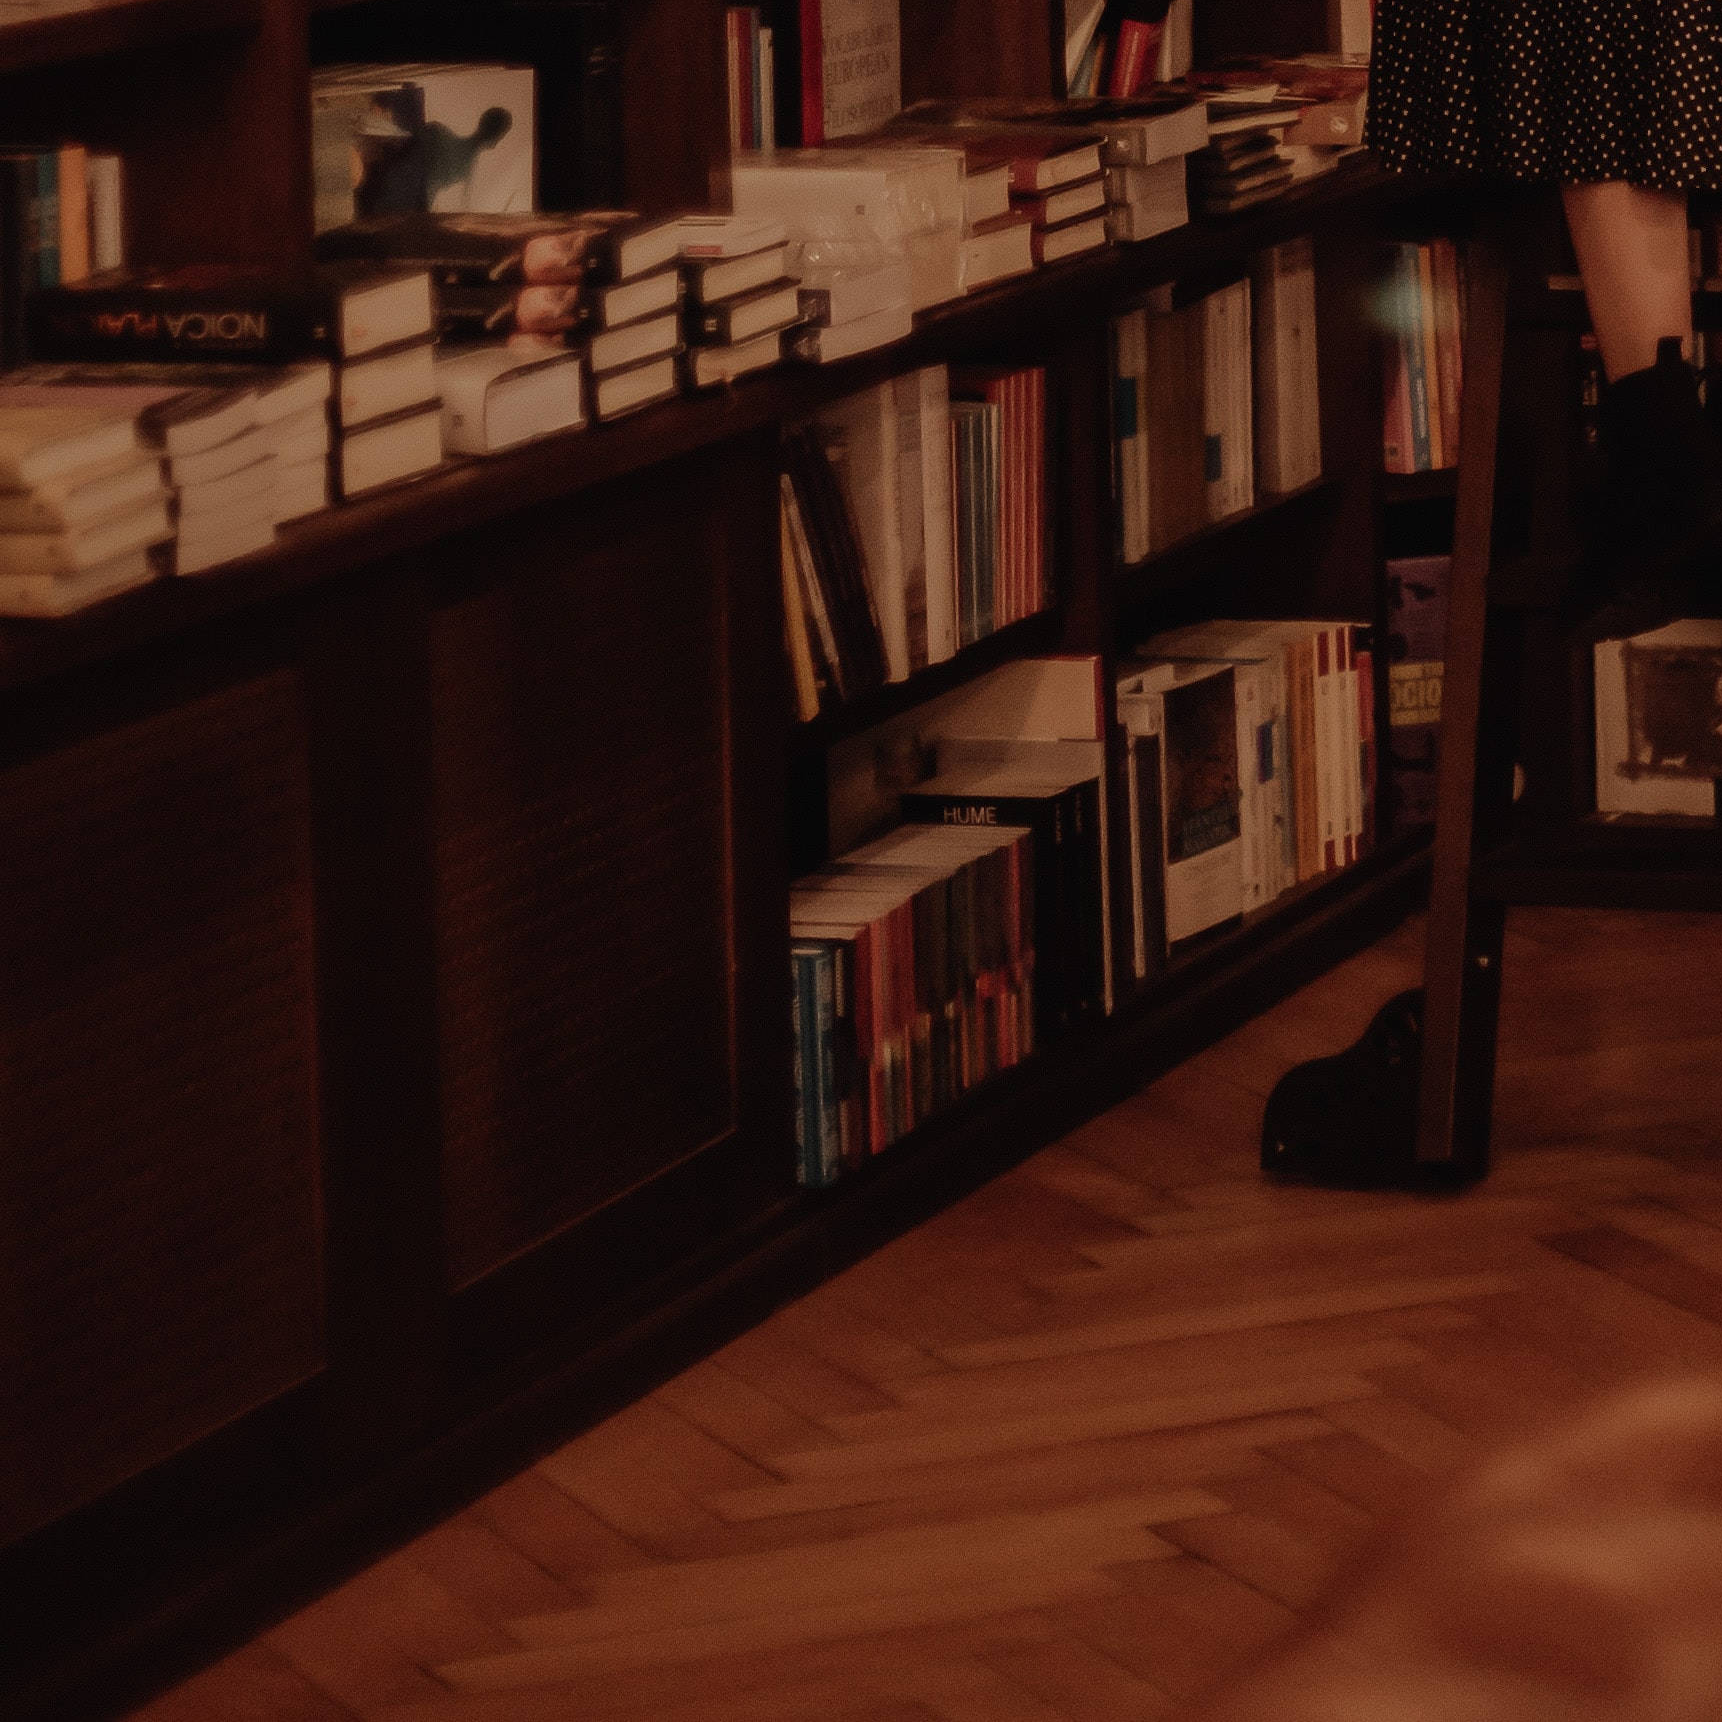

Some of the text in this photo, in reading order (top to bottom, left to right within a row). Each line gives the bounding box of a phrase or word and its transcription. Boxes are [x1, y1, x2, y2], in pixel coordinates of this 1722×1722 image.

[164, 312, 267, 340] NOICA
[1390, 677, 1443, 709] OCIO
[943, 806, 998, 825] HUME
